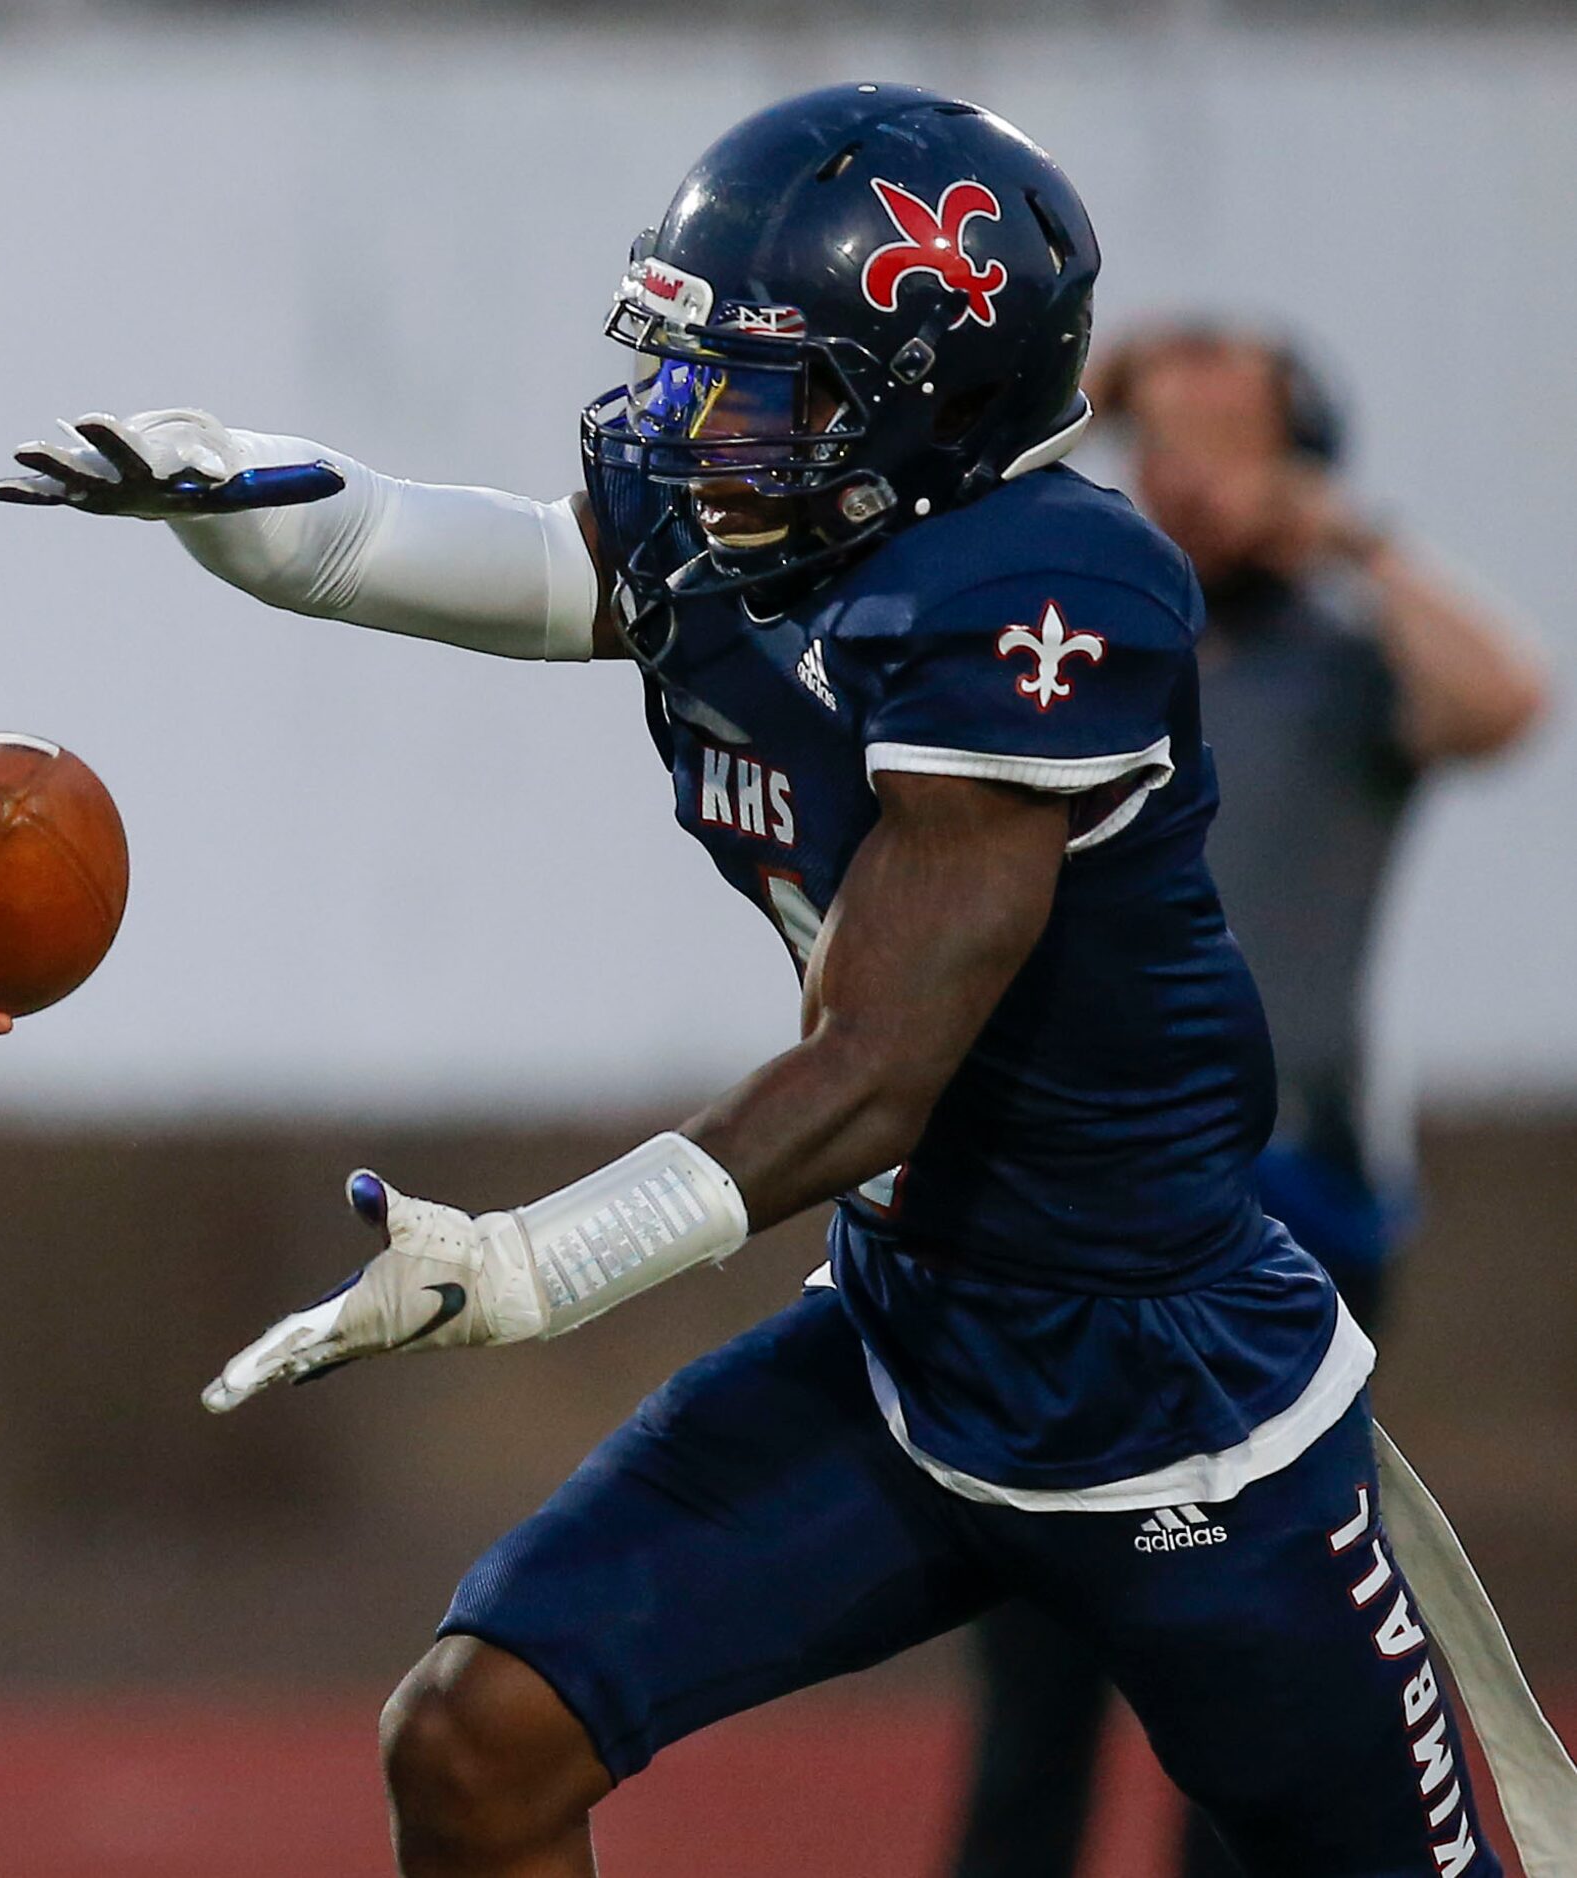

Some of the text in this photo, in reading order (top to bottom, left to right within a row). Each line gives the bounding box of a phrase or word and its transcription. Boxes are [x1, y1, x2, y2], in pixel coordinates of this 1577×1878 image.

[701, 746, 795, 845] KHS
[1134, 1525, 1228, 1552] adidas
[1328, 1486, 1478, 1878] KIMBALL
